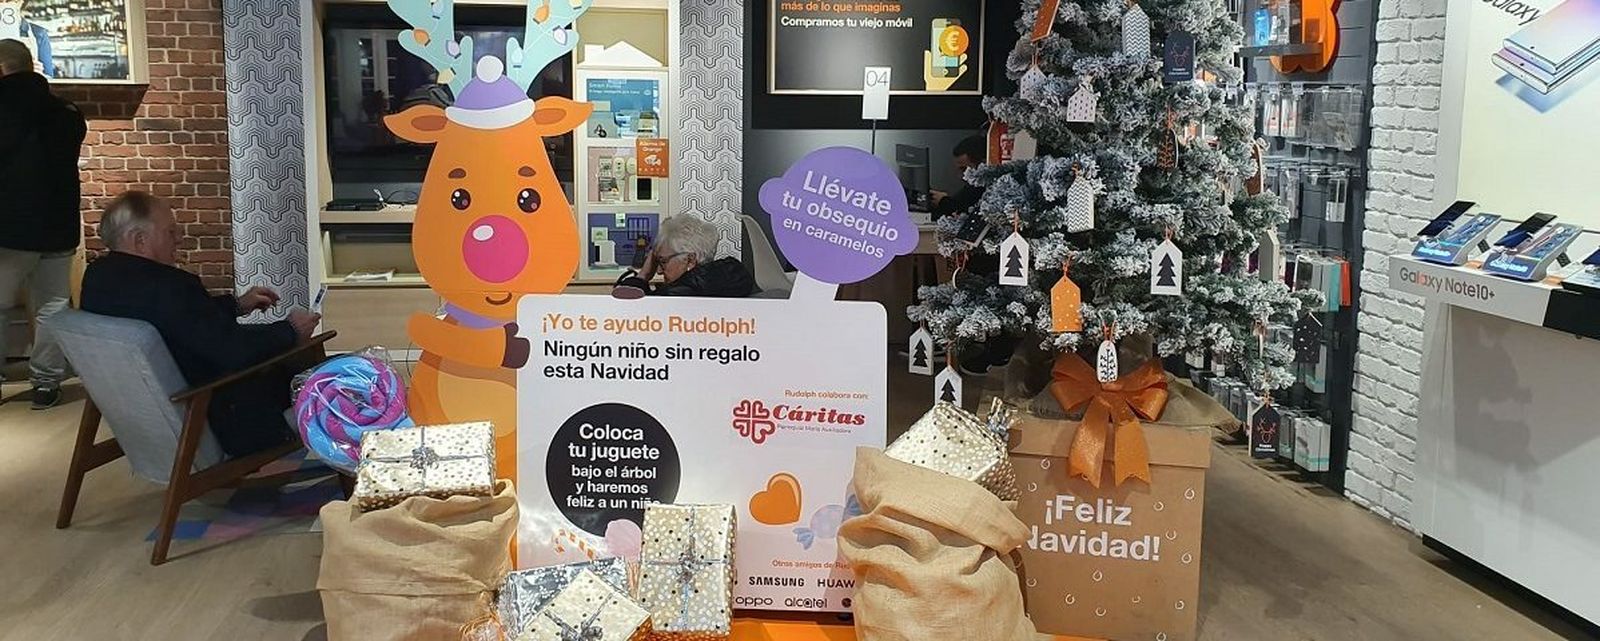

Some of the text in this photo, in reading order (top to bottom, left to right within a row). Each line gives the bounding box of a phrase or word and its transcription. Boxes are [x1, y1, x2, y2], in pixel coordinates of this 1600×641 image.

[0, 7, 16, 25] 3
[781, 1, 901, 13] más de lo que imaginas
[1482, 0, 1540, 26] alaxy
[781, 16, 913, 29] Compramos tu viejo móvil
[866, 70, 889, 88] 04
[802, 170, 892, 216] Llévate
[782, 190, 899, 242] tu obsequio
[783, 218, 885, 259] en caramelos
[1400, 267, 1496, 301] Galaxy Note10+
[542, 313, 756, 338] ¡Yo te ayudo Rudolph!
[543, 340, 761, 364] Ningún niño sin regalo
[543, 363, 670, 381] esta Navidad
[784, 389, 817, 399] Rudolph
[818, 390, 852, 400] colabora
[772, 404, 866, 426] Cáritas
[579, 423, 644, 441] Coloca
[567, 442, 661, 463] tu juguete
[571, 464, 657, 480] bajo el árbol
[575, 480, 649, 495] y haremos
[566, 495, 595, 508] feliz
[597, 498, 607, 509] a
[610, 499, 628, 509] un
[1044, 493, 1133, 526] ¡Feliz
[748, 576, 805, 588] SAMSUNG
[735, 596, 828, 609] oppo alcatel
